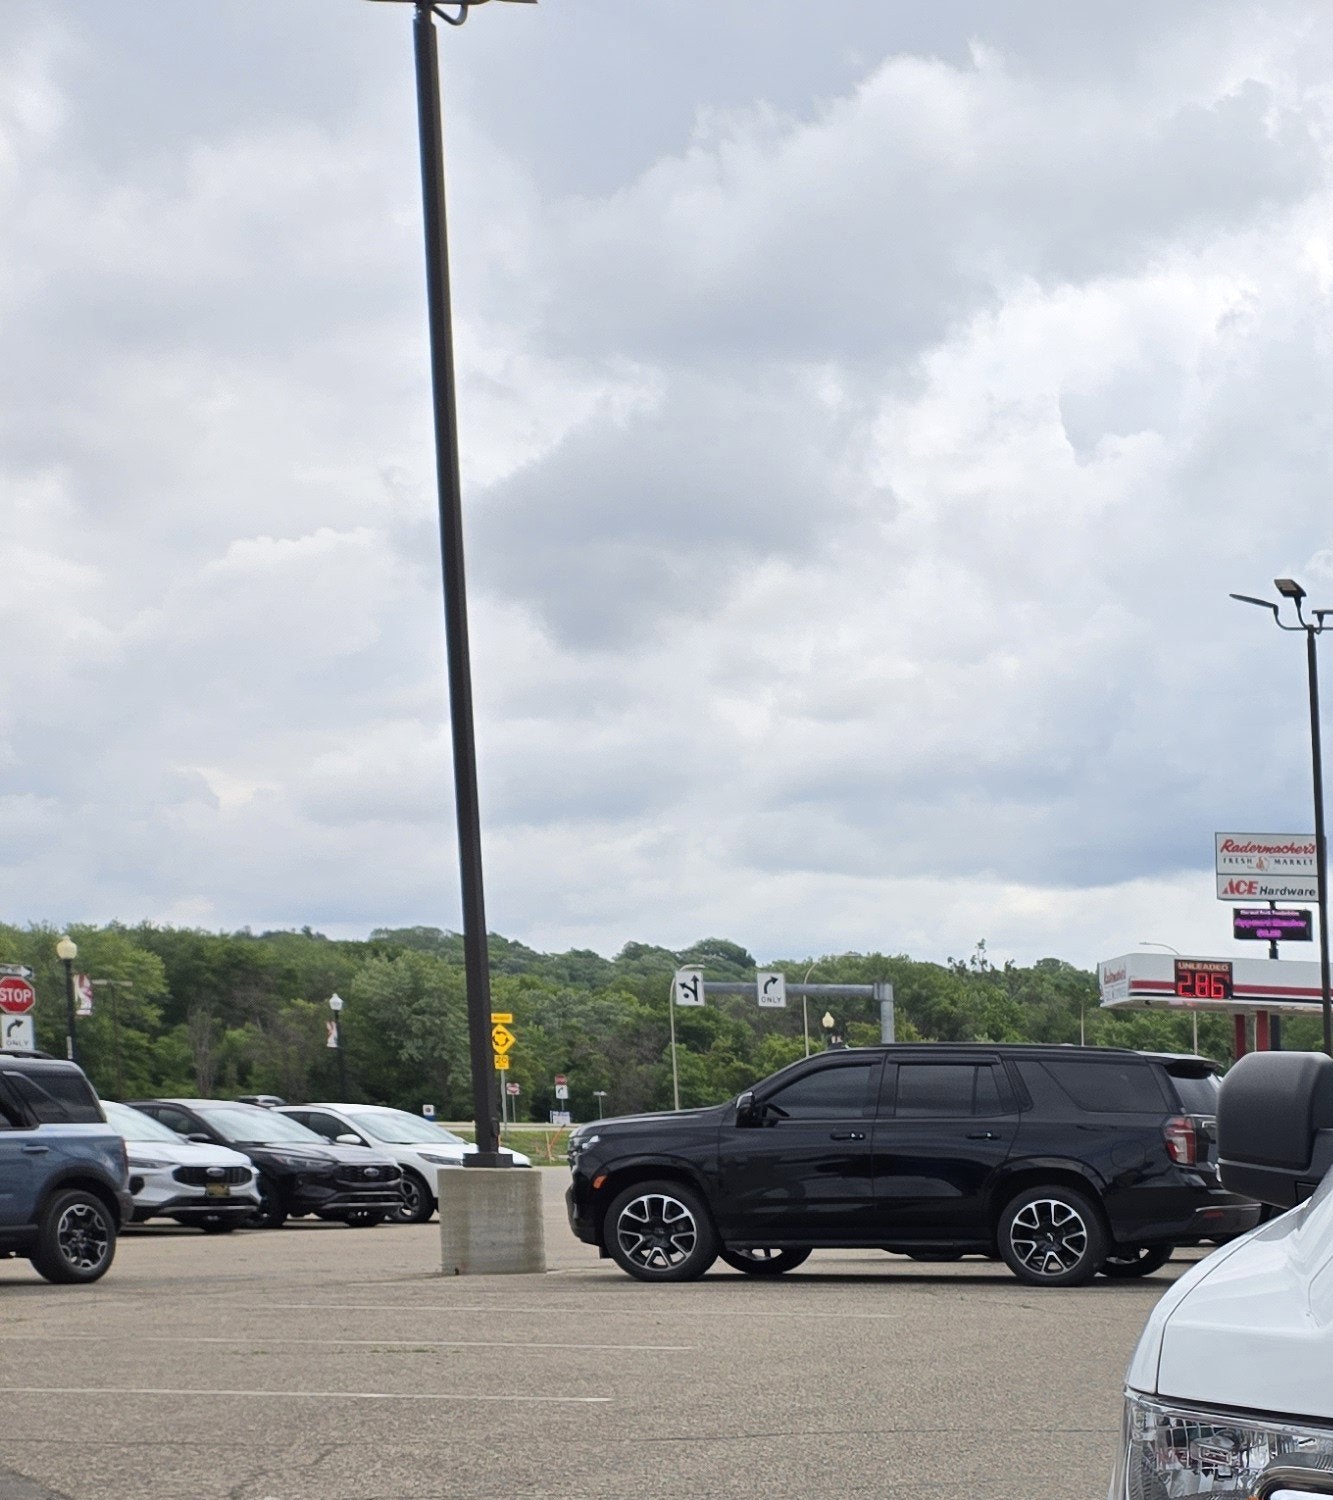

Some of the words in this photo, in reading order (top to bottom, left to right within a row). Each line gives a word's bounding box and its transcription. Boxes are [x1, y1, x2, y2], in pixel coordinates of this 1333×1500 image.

[1220, 838, 1316, 855] Radermacher's
[1274, 858, 1313, 866] MARKET
[1222, 878, 1259, 896] ACE
[1260, 886, 1316, 897] Hardware
[1178, 962, 1229, 972] UNLEADED
[0, 987, 32, 1004] STOP
[760, 996, 782, 1004] ONLY
